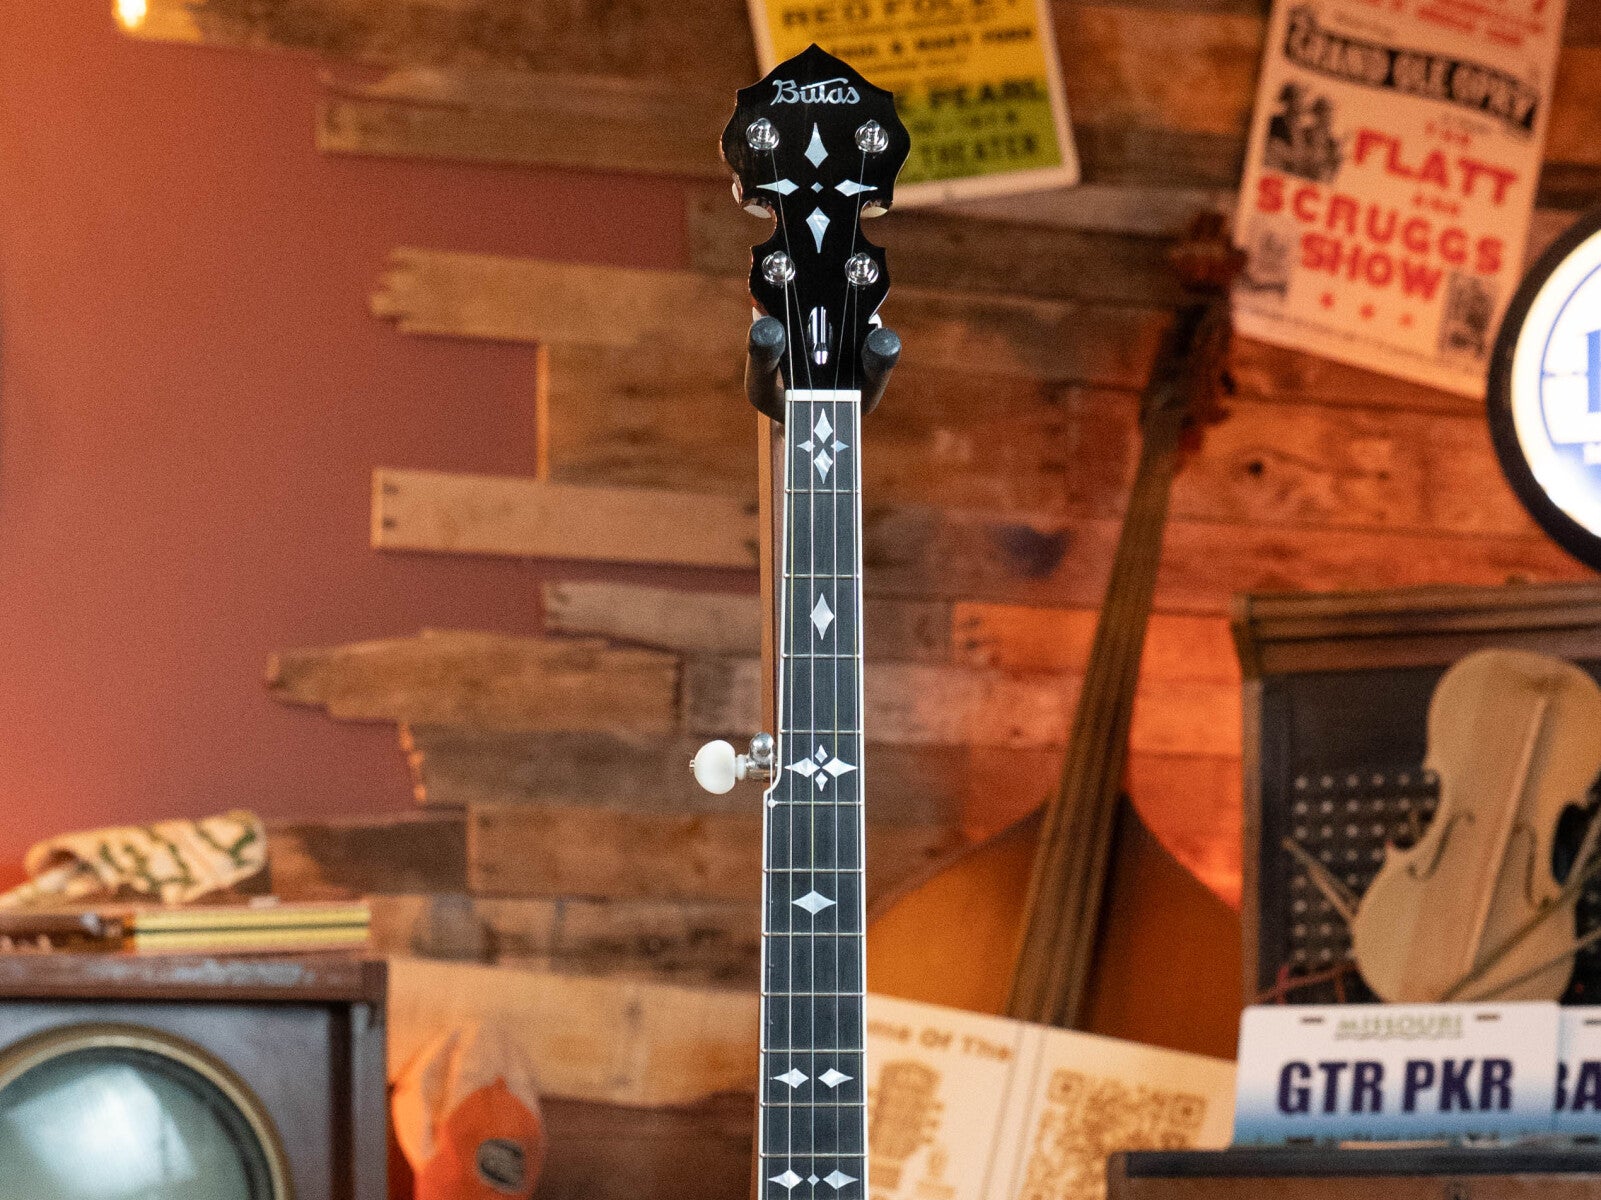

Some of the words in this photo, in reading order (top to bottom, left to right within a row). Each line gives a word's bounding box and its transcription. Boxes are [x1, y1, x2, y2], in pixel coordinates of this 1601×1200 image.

[1355, 126, 1519, 208] FLATT
[1256, 174, 1504, 276] SCRUGGS
[1300, 232, 1443, 301] SHOW
[1276, 1060, 1385, 1115] GTR
[1402, 1058, 1514, 1114] PKR
